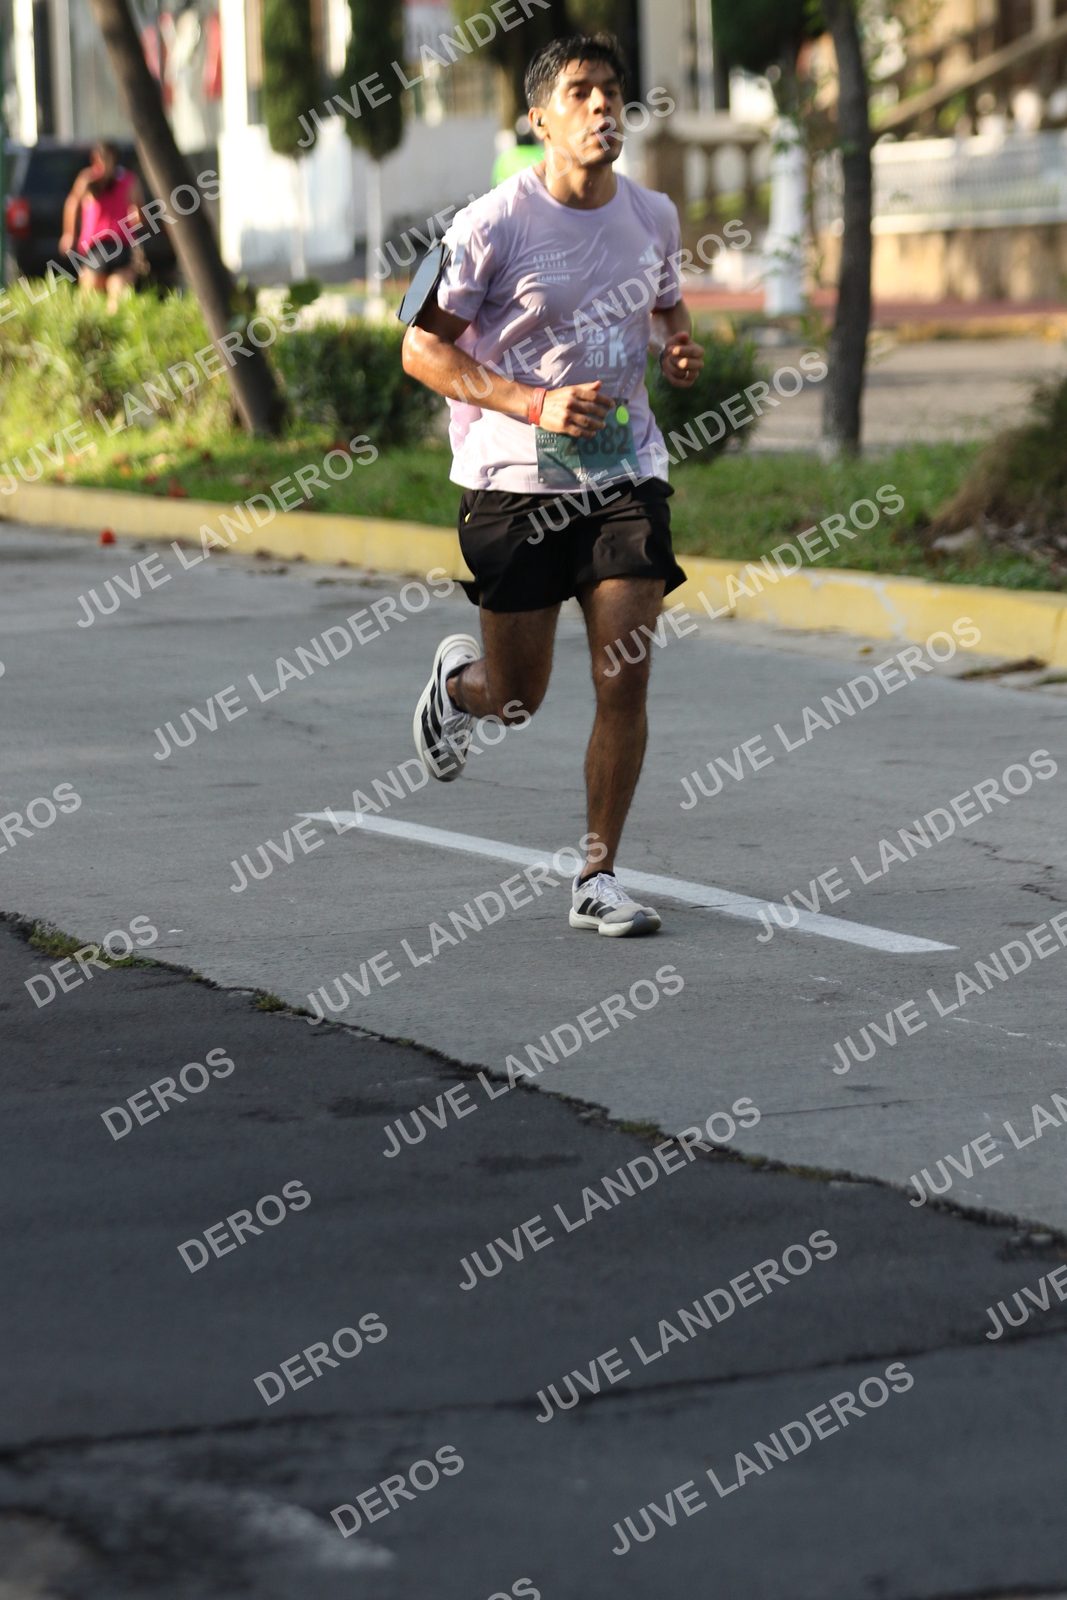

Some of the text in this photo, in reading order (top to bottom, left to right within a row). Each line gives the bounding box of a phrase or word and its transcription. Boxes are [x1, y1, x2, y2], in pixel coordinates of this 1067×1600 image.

[586, 328, 605, 345] 15
[609, 326, 627, 368] K
[584, 351, 604, 368] 30
